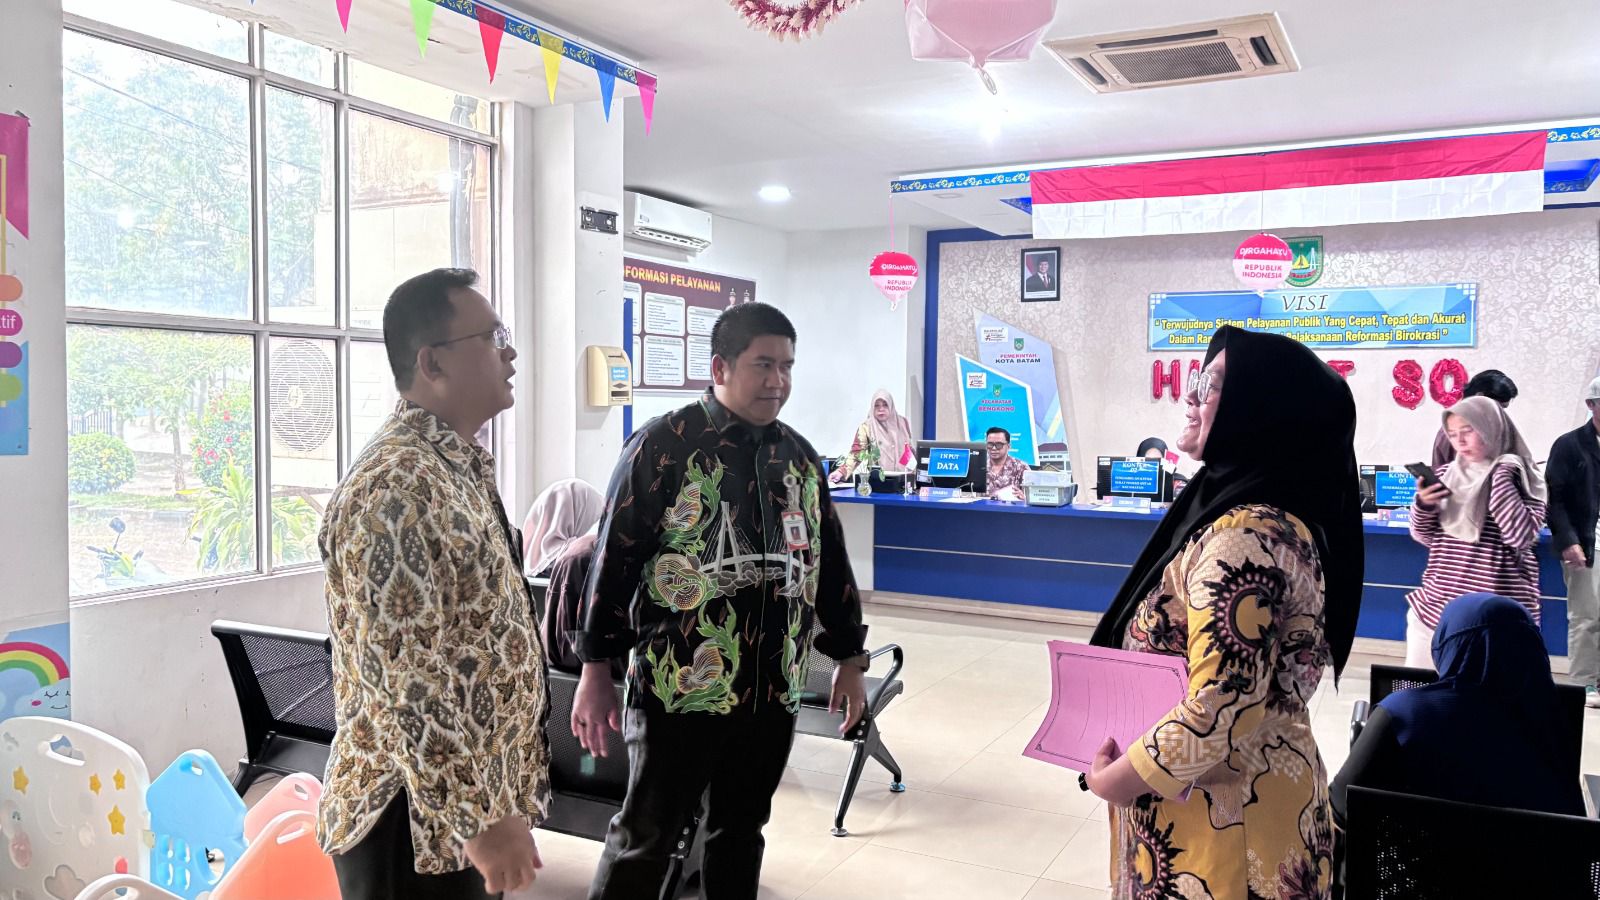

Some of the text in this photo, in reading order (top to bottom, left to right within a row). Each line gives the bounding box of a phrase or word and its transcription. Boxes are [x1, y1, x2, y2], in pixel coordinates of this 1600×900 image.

[623, 265, 721, 293] FORMASI PELAYANAN
[1242, 271, 1283, 279] INDONESIA
[1282, 294, 1329, 311] VISI
[0, 315, 16, 329] tif
[1161, 319, 1214, 331] Terwujudnya
[1246, 317, 1291, 330] Pelayanan
[1293, 315, 1321, 327] Publik
[1323, 315, 1346, 329] Yang
[1348, 315, 1379, 328] Cepat,
[1381, 314, 1409, 327] Tepat
[1411, 313, 1429, 325] dan
[1431, 312, 1466, 325] Akurat
[1168, 333, 1195, 345] Dalam
[1345, 330, 1393, 342] Reformasi
[1395, 329, 1441, 342] Birokrasi
[936, 462, 960, 471] DATA
